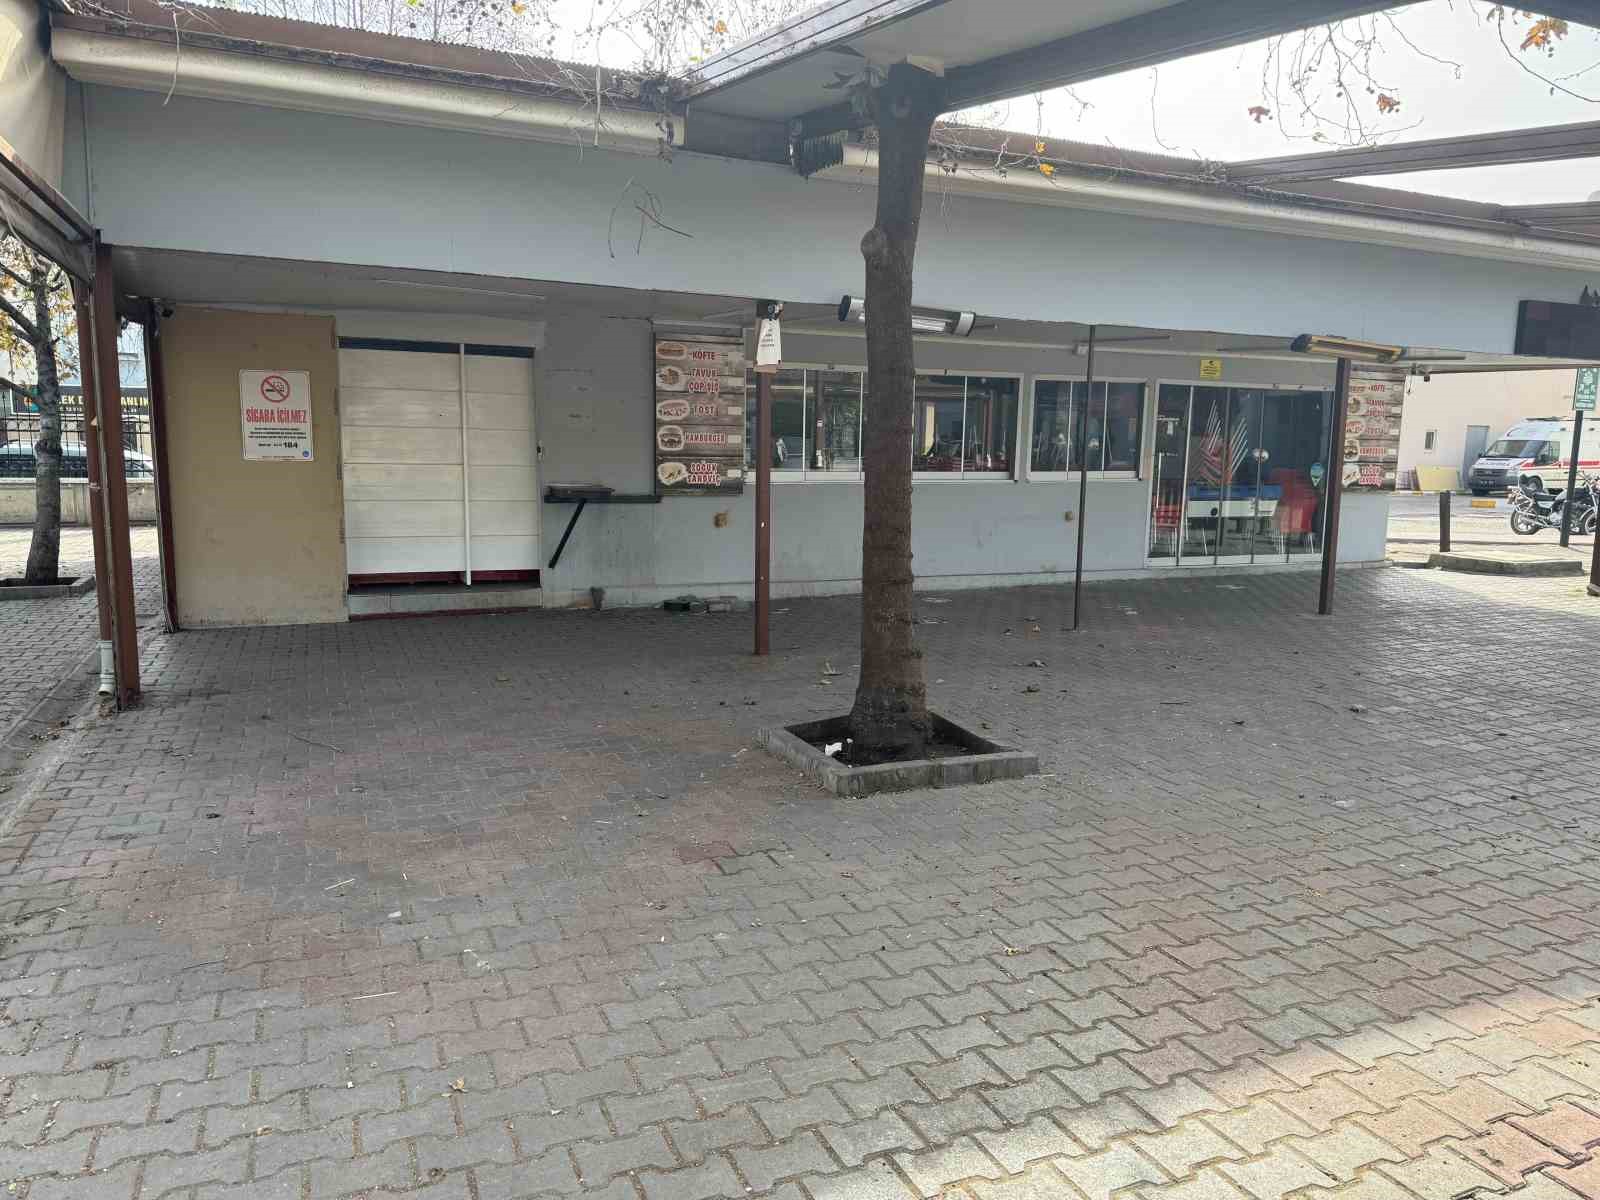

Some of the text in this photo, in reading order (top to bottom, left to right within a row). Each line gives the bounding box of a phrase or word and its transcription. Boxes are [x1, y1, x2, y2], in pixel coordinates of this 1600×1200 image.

[693, 347, 715, 360] KÖFTE
[246, 407, 306, 423] SİGARA İÇİLMEZ
